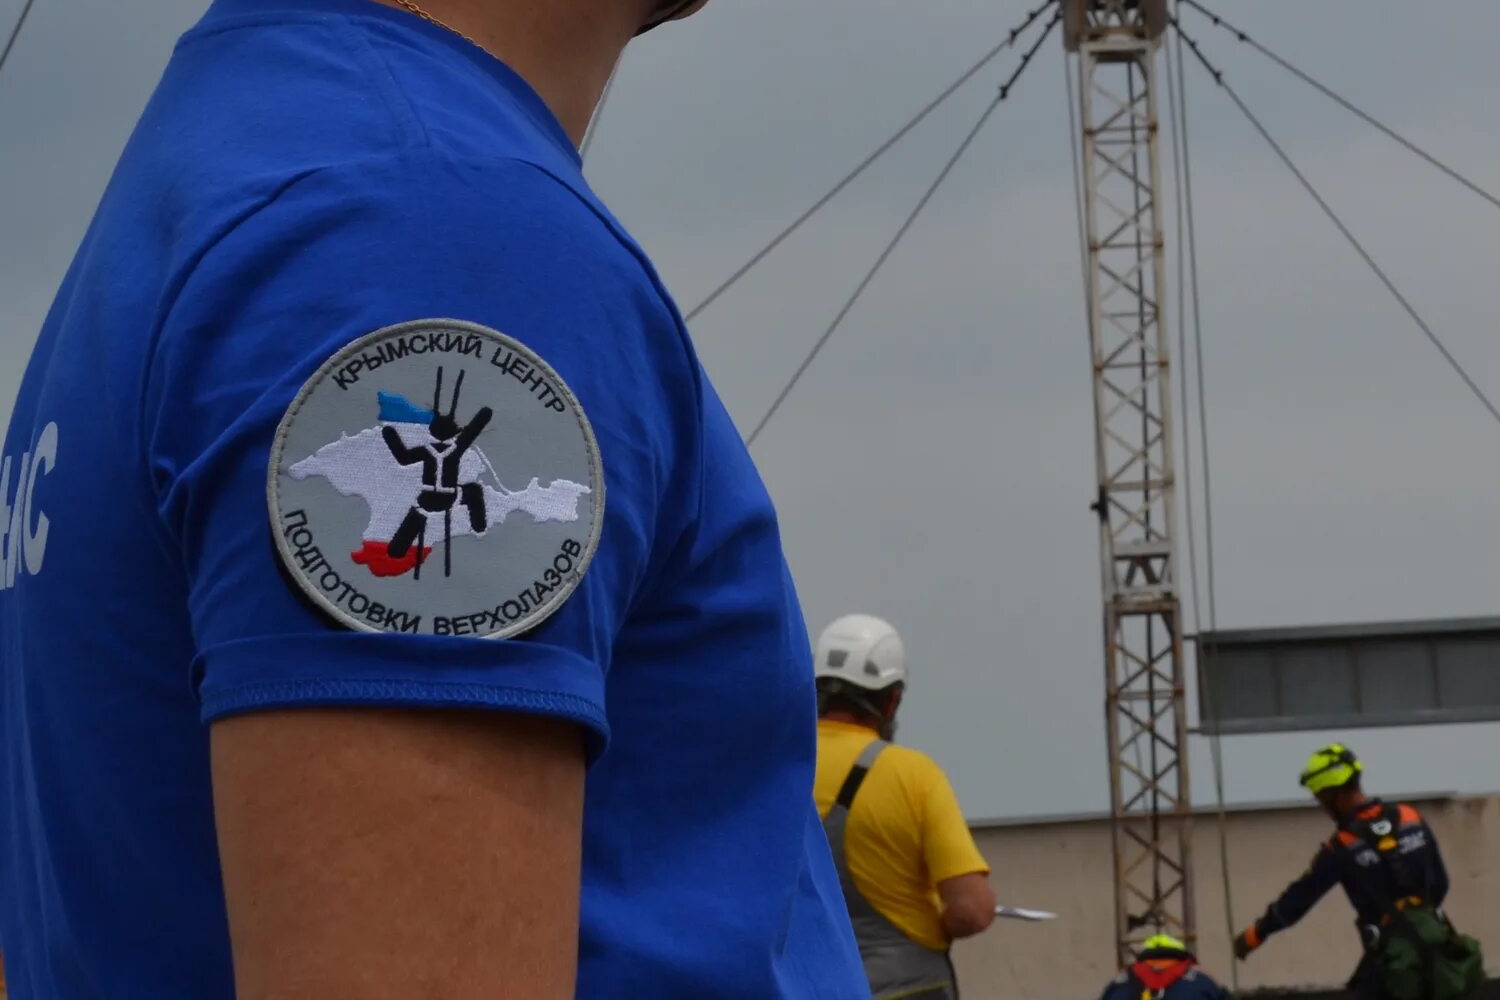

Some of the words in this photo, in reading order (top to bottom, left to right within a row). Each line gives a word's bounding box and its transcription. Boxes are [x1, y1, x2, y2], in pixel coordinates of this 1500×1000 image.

[332, 332, 483, 391] КРЫМСКИЙ
[491, 347, 566, 414] ЦЕНТР
[284, 510, 420, 634] ПОДГОТОВКИ
[434, 538, 581, 636] ВЕРХОЛАЗОВ
